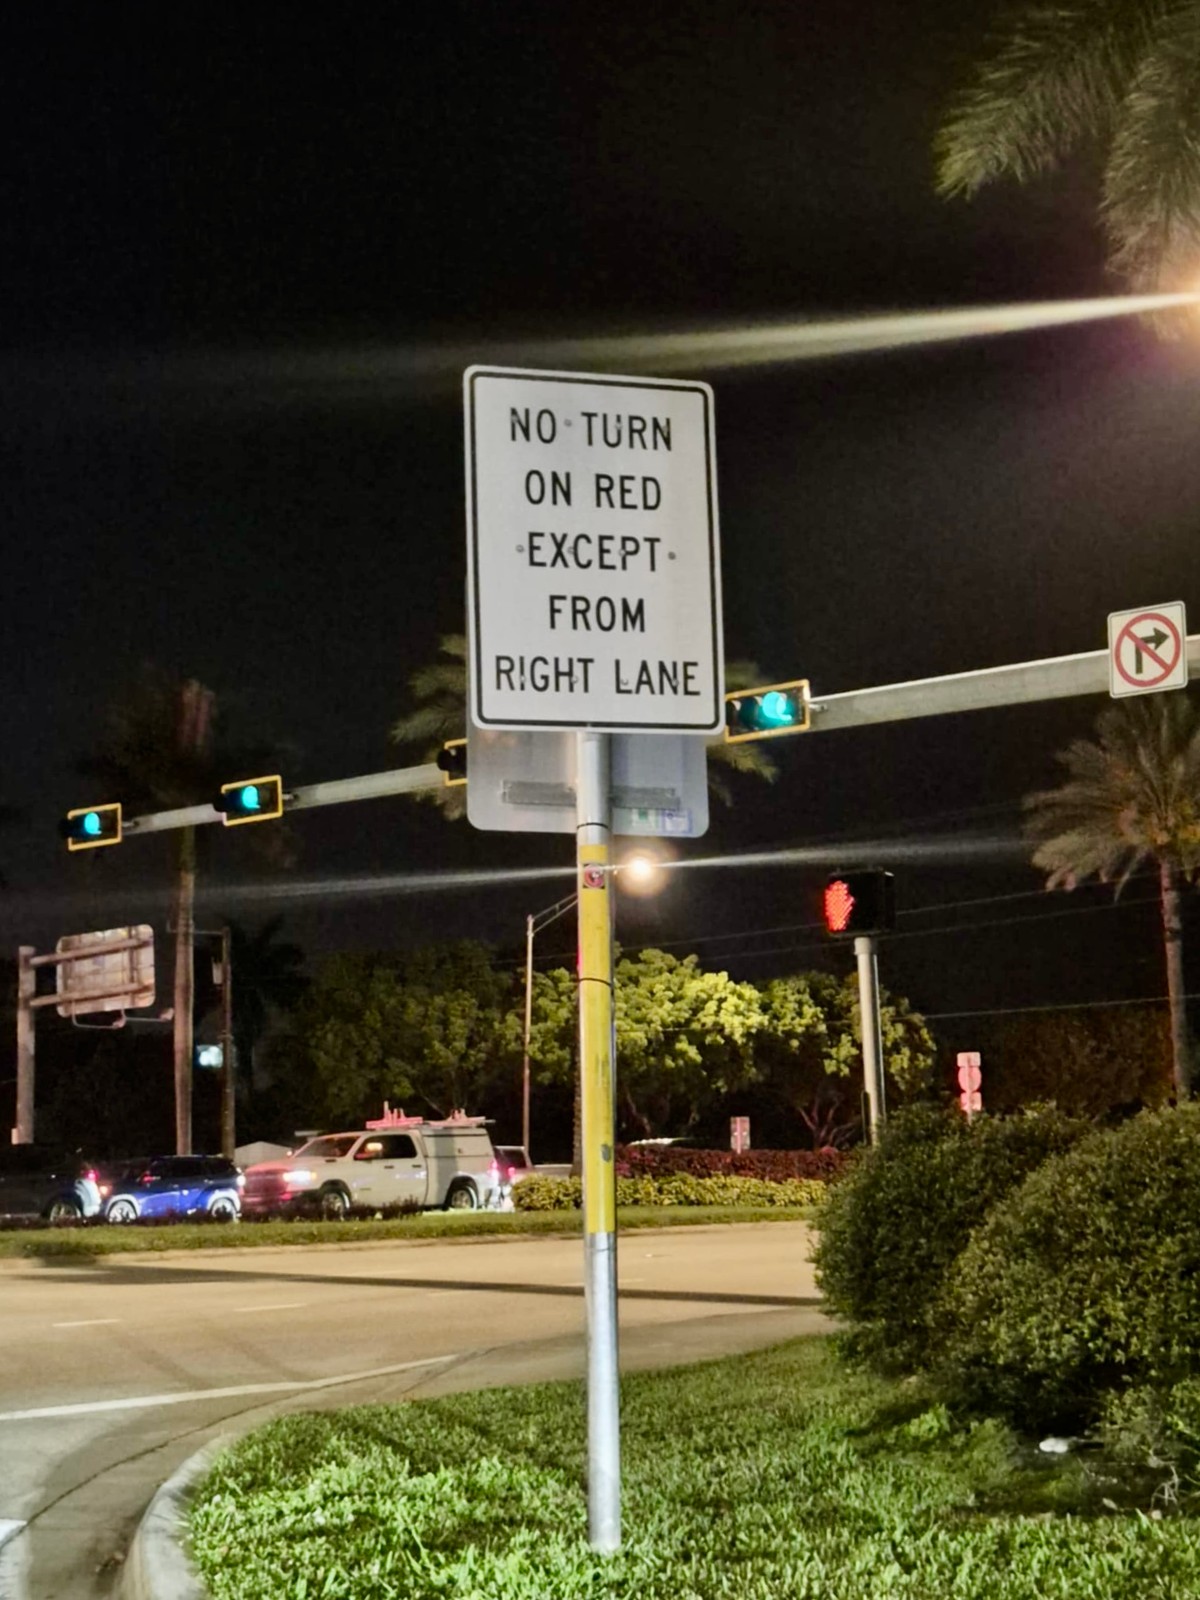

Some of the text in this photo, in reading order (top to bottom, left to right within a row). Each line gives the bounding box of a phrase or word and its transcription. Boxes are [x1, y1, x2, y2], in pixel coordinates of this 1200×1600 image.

[510, 407, 672, 451] NO TURN
[525, 469, 661, 511] ON RED
[528, 532, 661, 572] EXCEPT
[549, 594, 645, 633] FROM
[495, 655, 701, 696] RIGHT LANE
